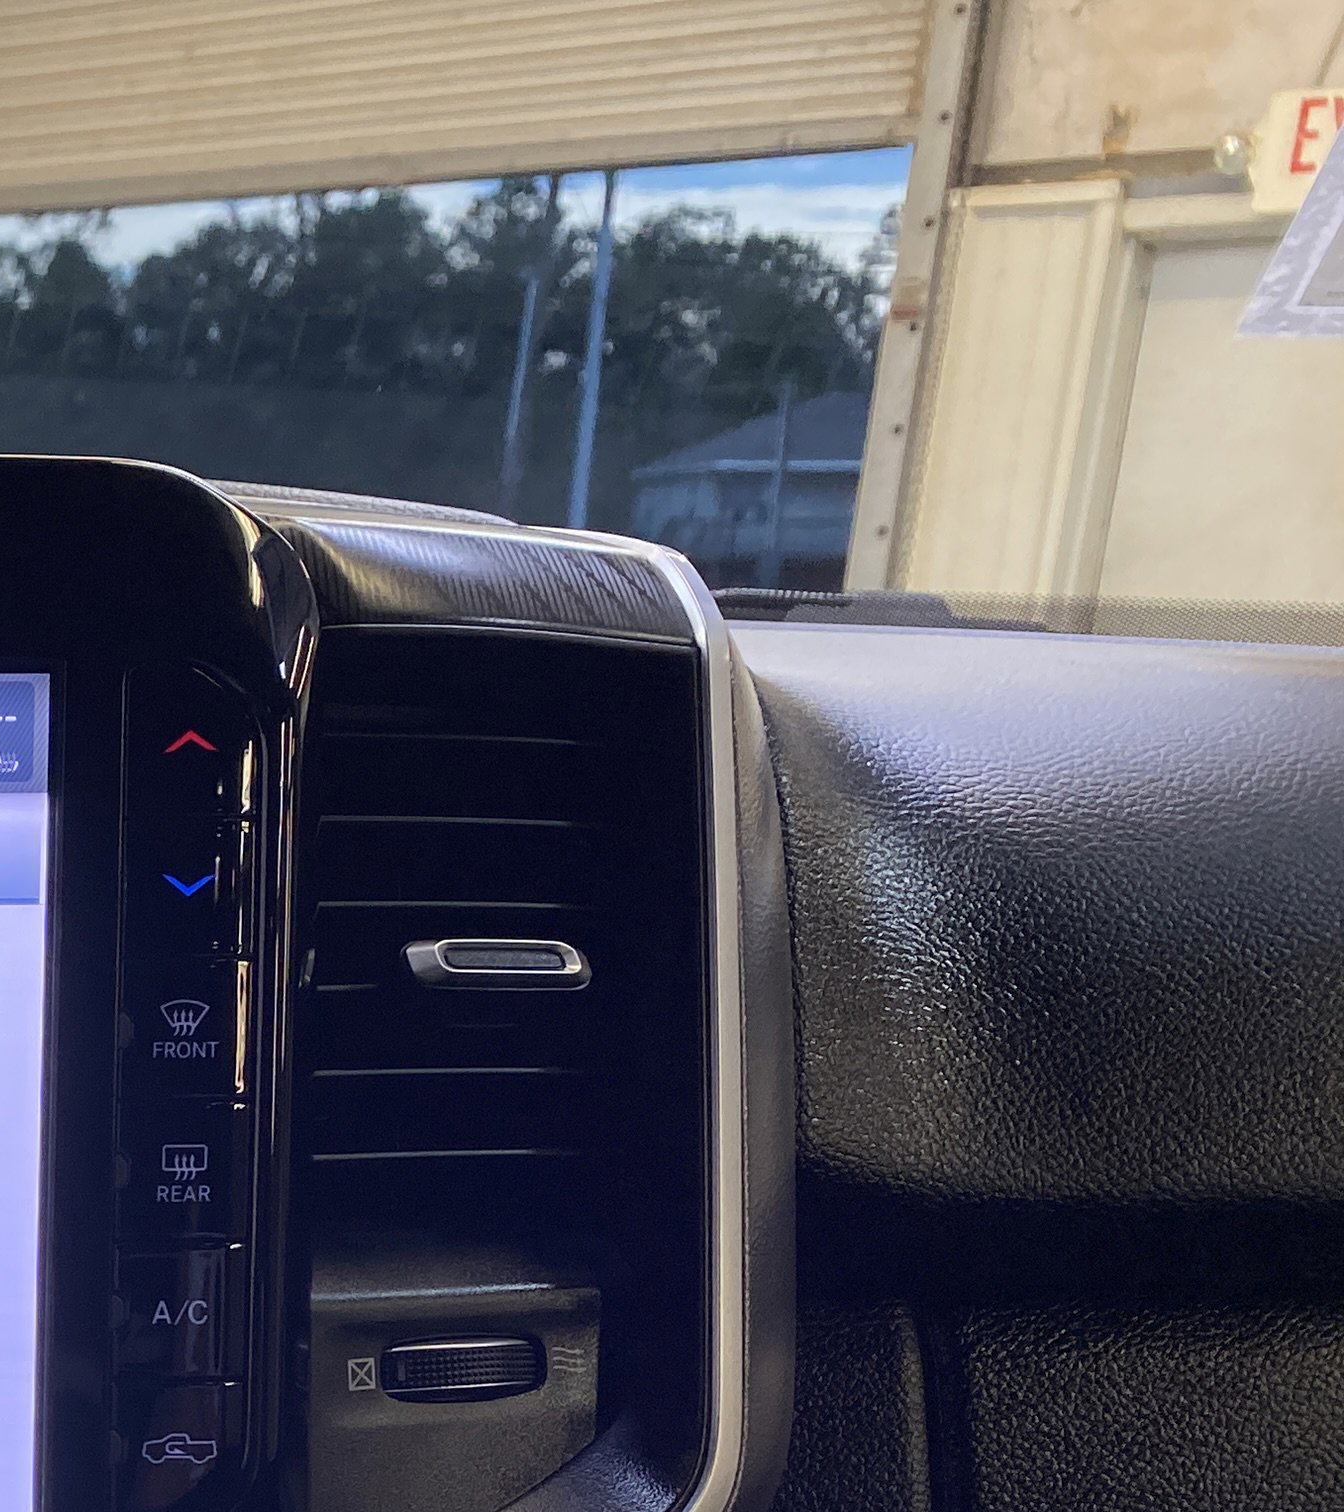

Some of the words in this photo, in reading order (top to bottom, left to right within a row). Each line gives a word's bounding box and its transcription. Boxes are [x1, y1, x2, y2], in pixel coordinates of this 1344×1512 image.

[1289, 96, 1343, 174] E
[152, 1040, 220, 1059] FRONT
[156, 1184, 211, 1203] REAR
[151, 1299, 208, 1326] A/C
